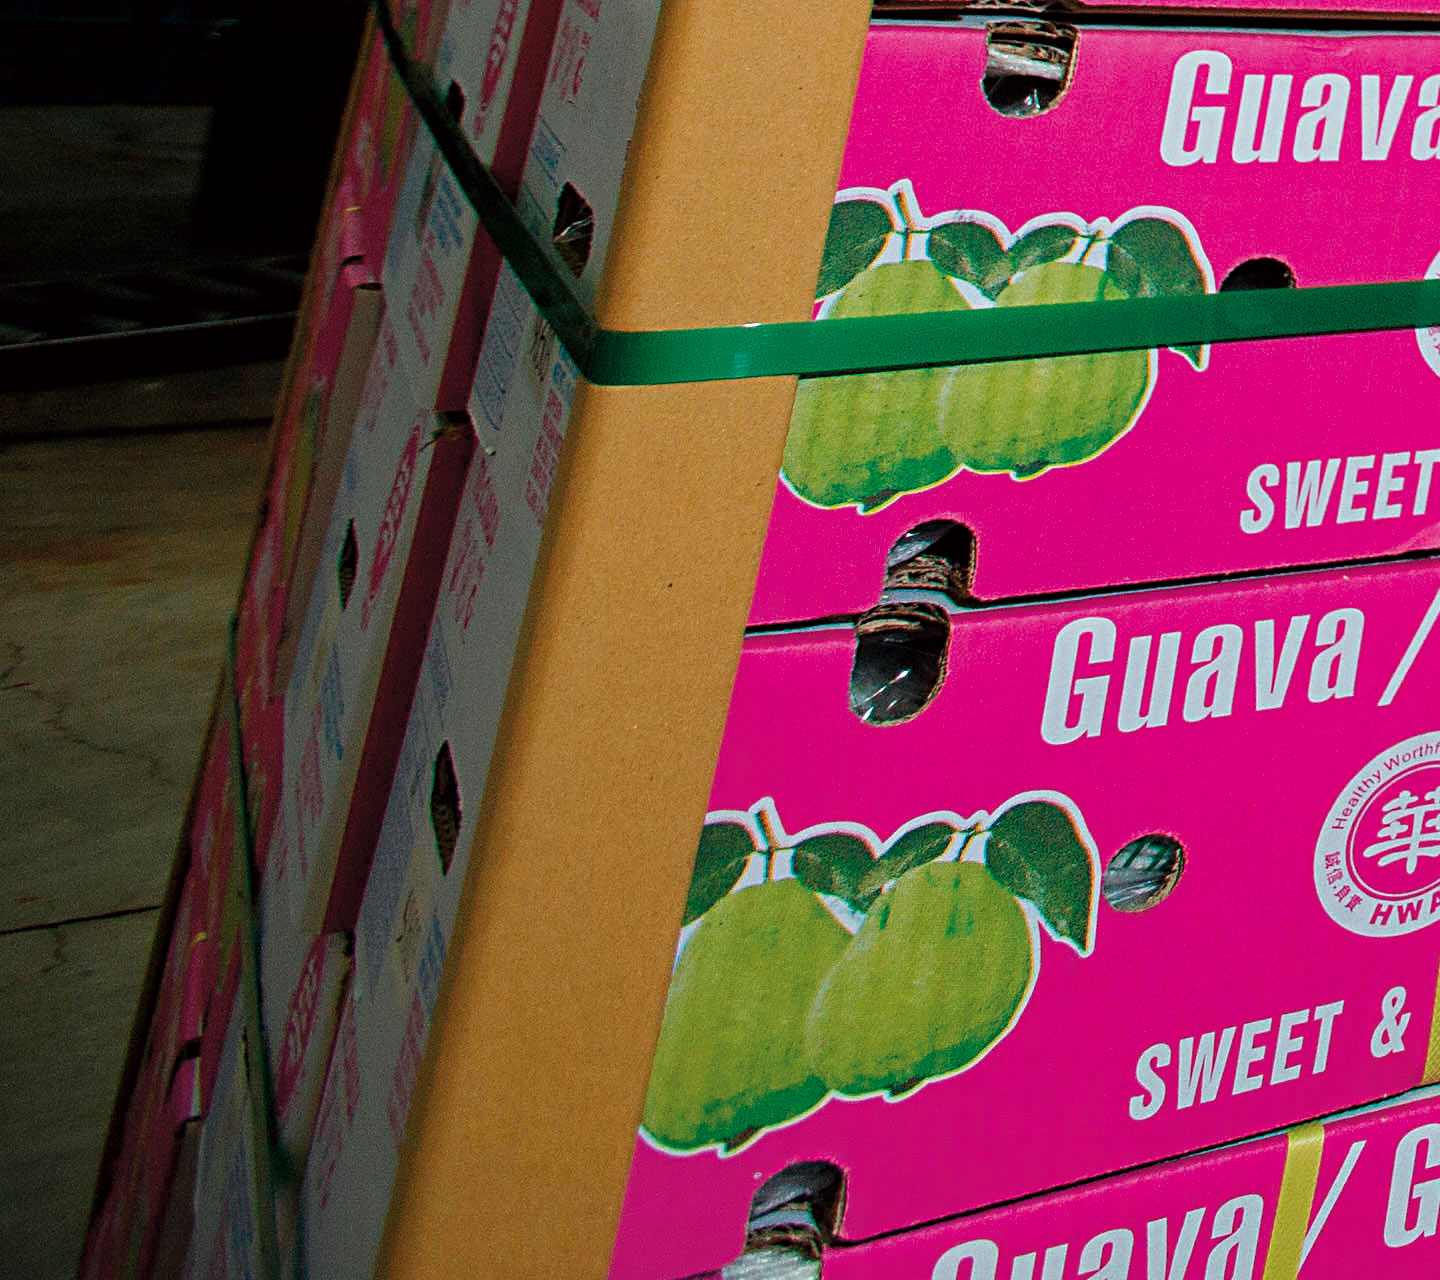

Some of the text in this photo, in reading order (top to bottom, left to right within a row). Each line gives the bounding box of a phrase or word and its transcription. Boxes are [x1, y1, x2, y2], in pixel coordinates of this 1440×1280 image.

[1041, 608, 1364, 745] Guava
[1333, 769, 1383, 831] Healthy
[1130, 1000, 1344, 1120] SWEET
[1371, 987, 1410, 1057] &
